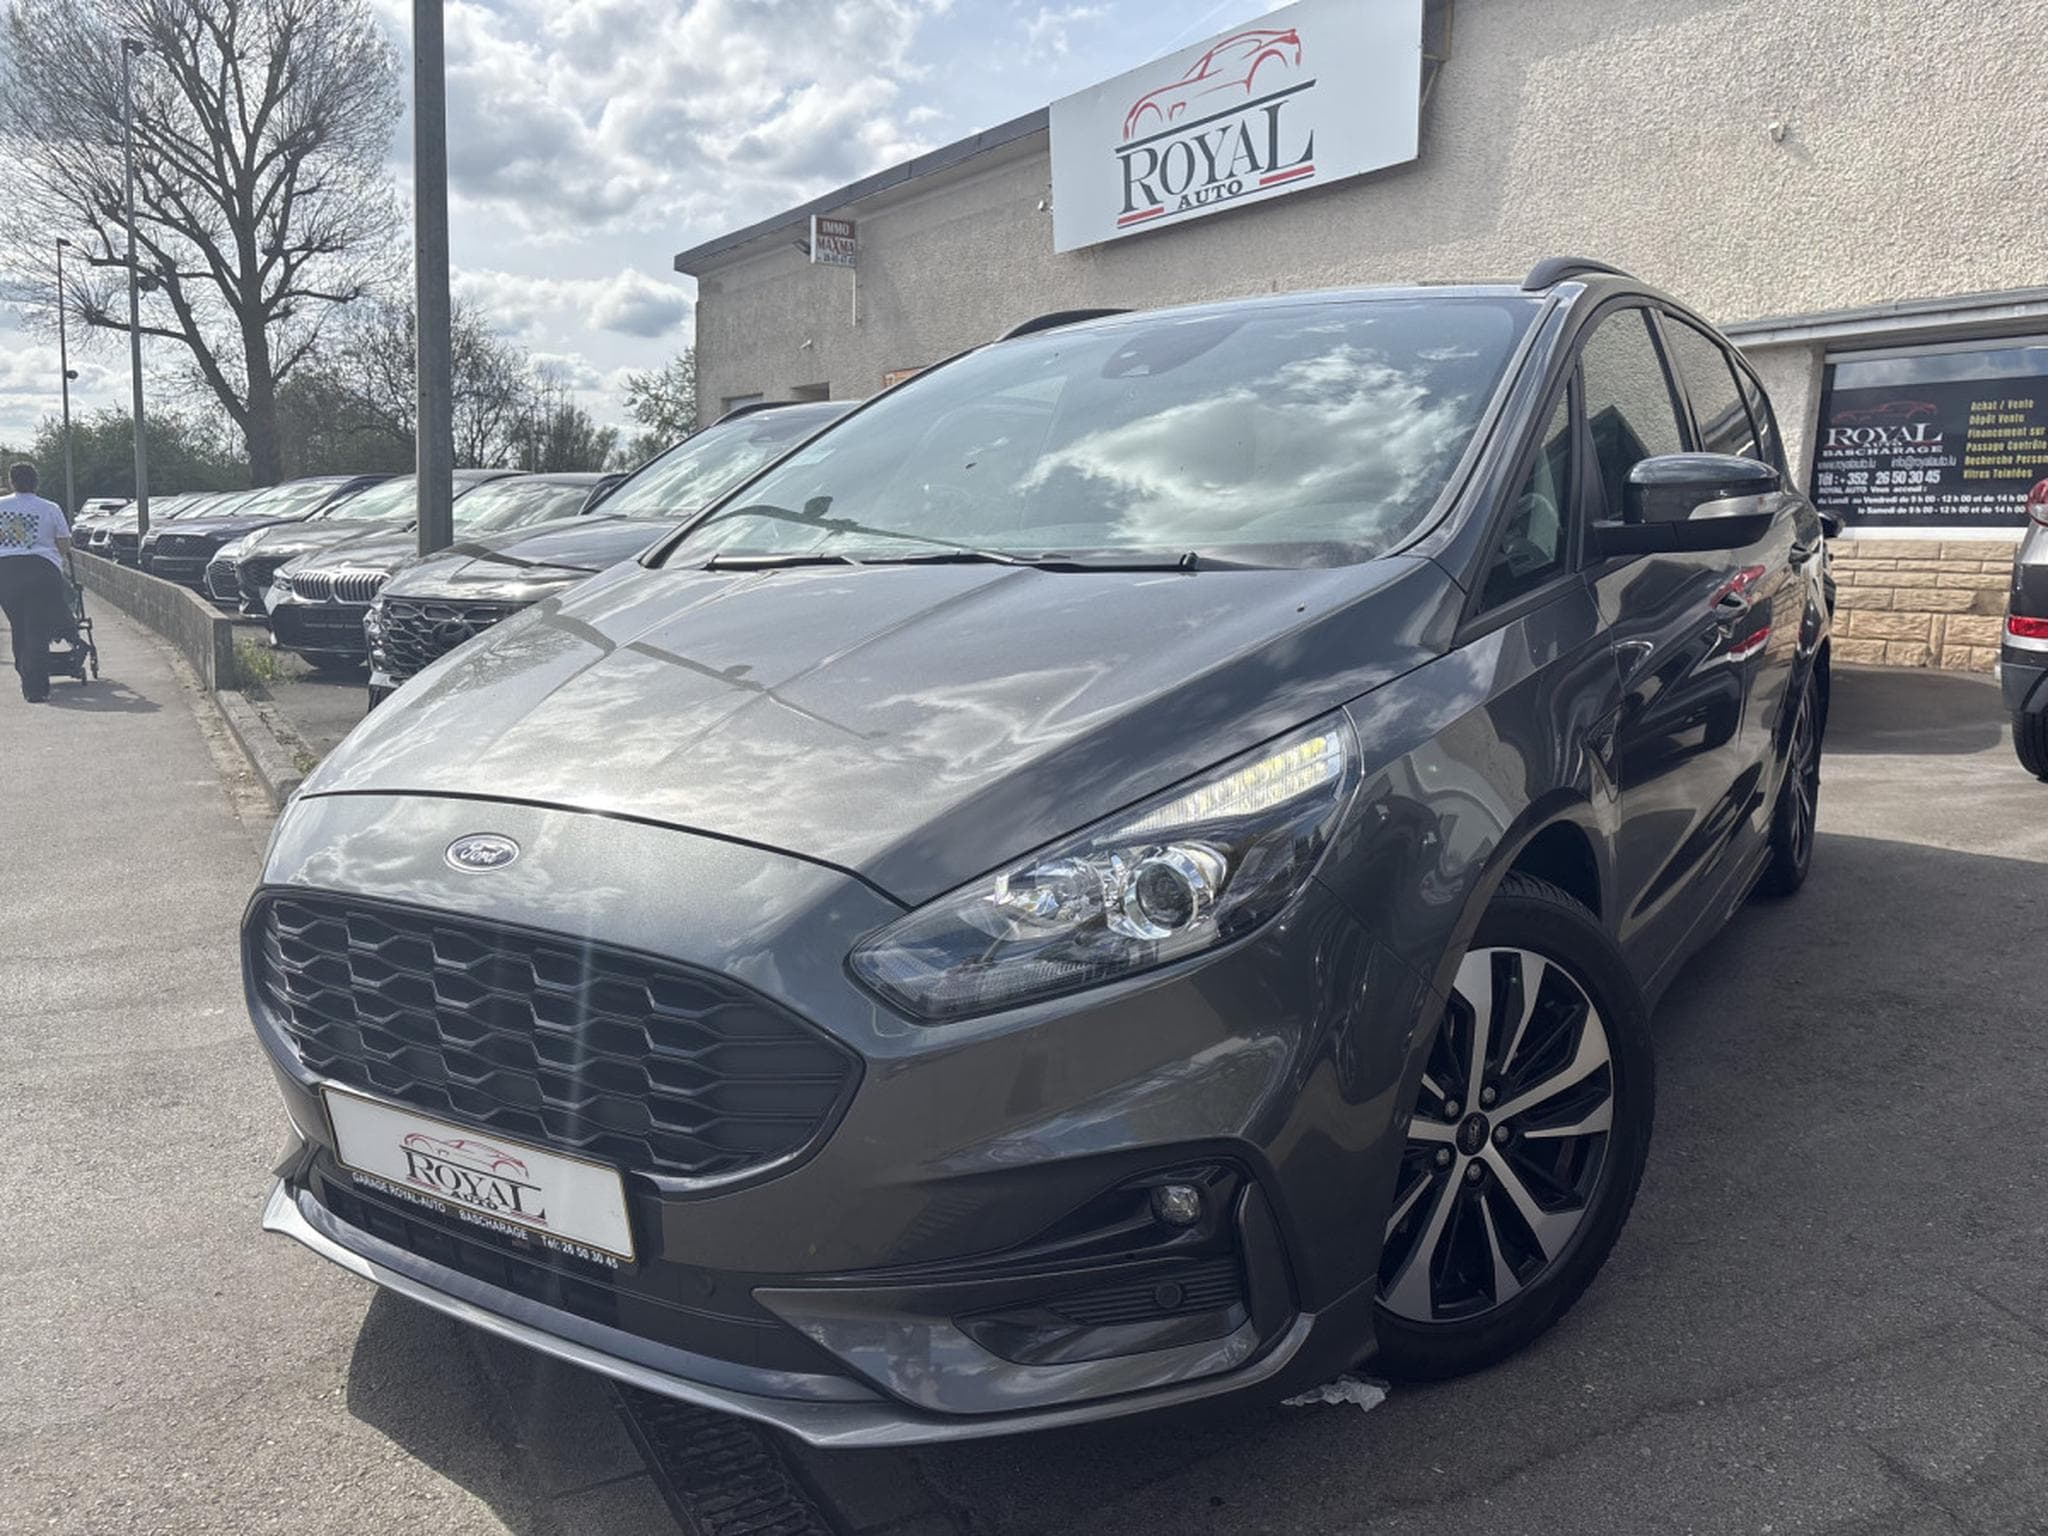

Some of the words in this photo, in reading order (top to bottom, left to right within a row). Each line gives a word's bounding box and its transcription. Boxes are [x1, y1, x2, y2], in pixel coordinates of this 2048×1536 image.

[1116, 100, 1314, 214] ROYAL
[1177, 179, 1244, 210] AUTO
[1825, 422, 1943, 447] ROYAL
[1823, 445, 1943, 456] BASCHARAGE
[1875, 470, 1891, 485] 26
[1892, 470, 1907, 485] 50
[1908, 470, 1924, 484] 30
[1925, 469, 1941, 484] 45
[403, 1150, 547, 1219] ROYAL
[458, 1209, 529, 1241] BASCHARAGE
[606, 1256, 619, 1269] 45
